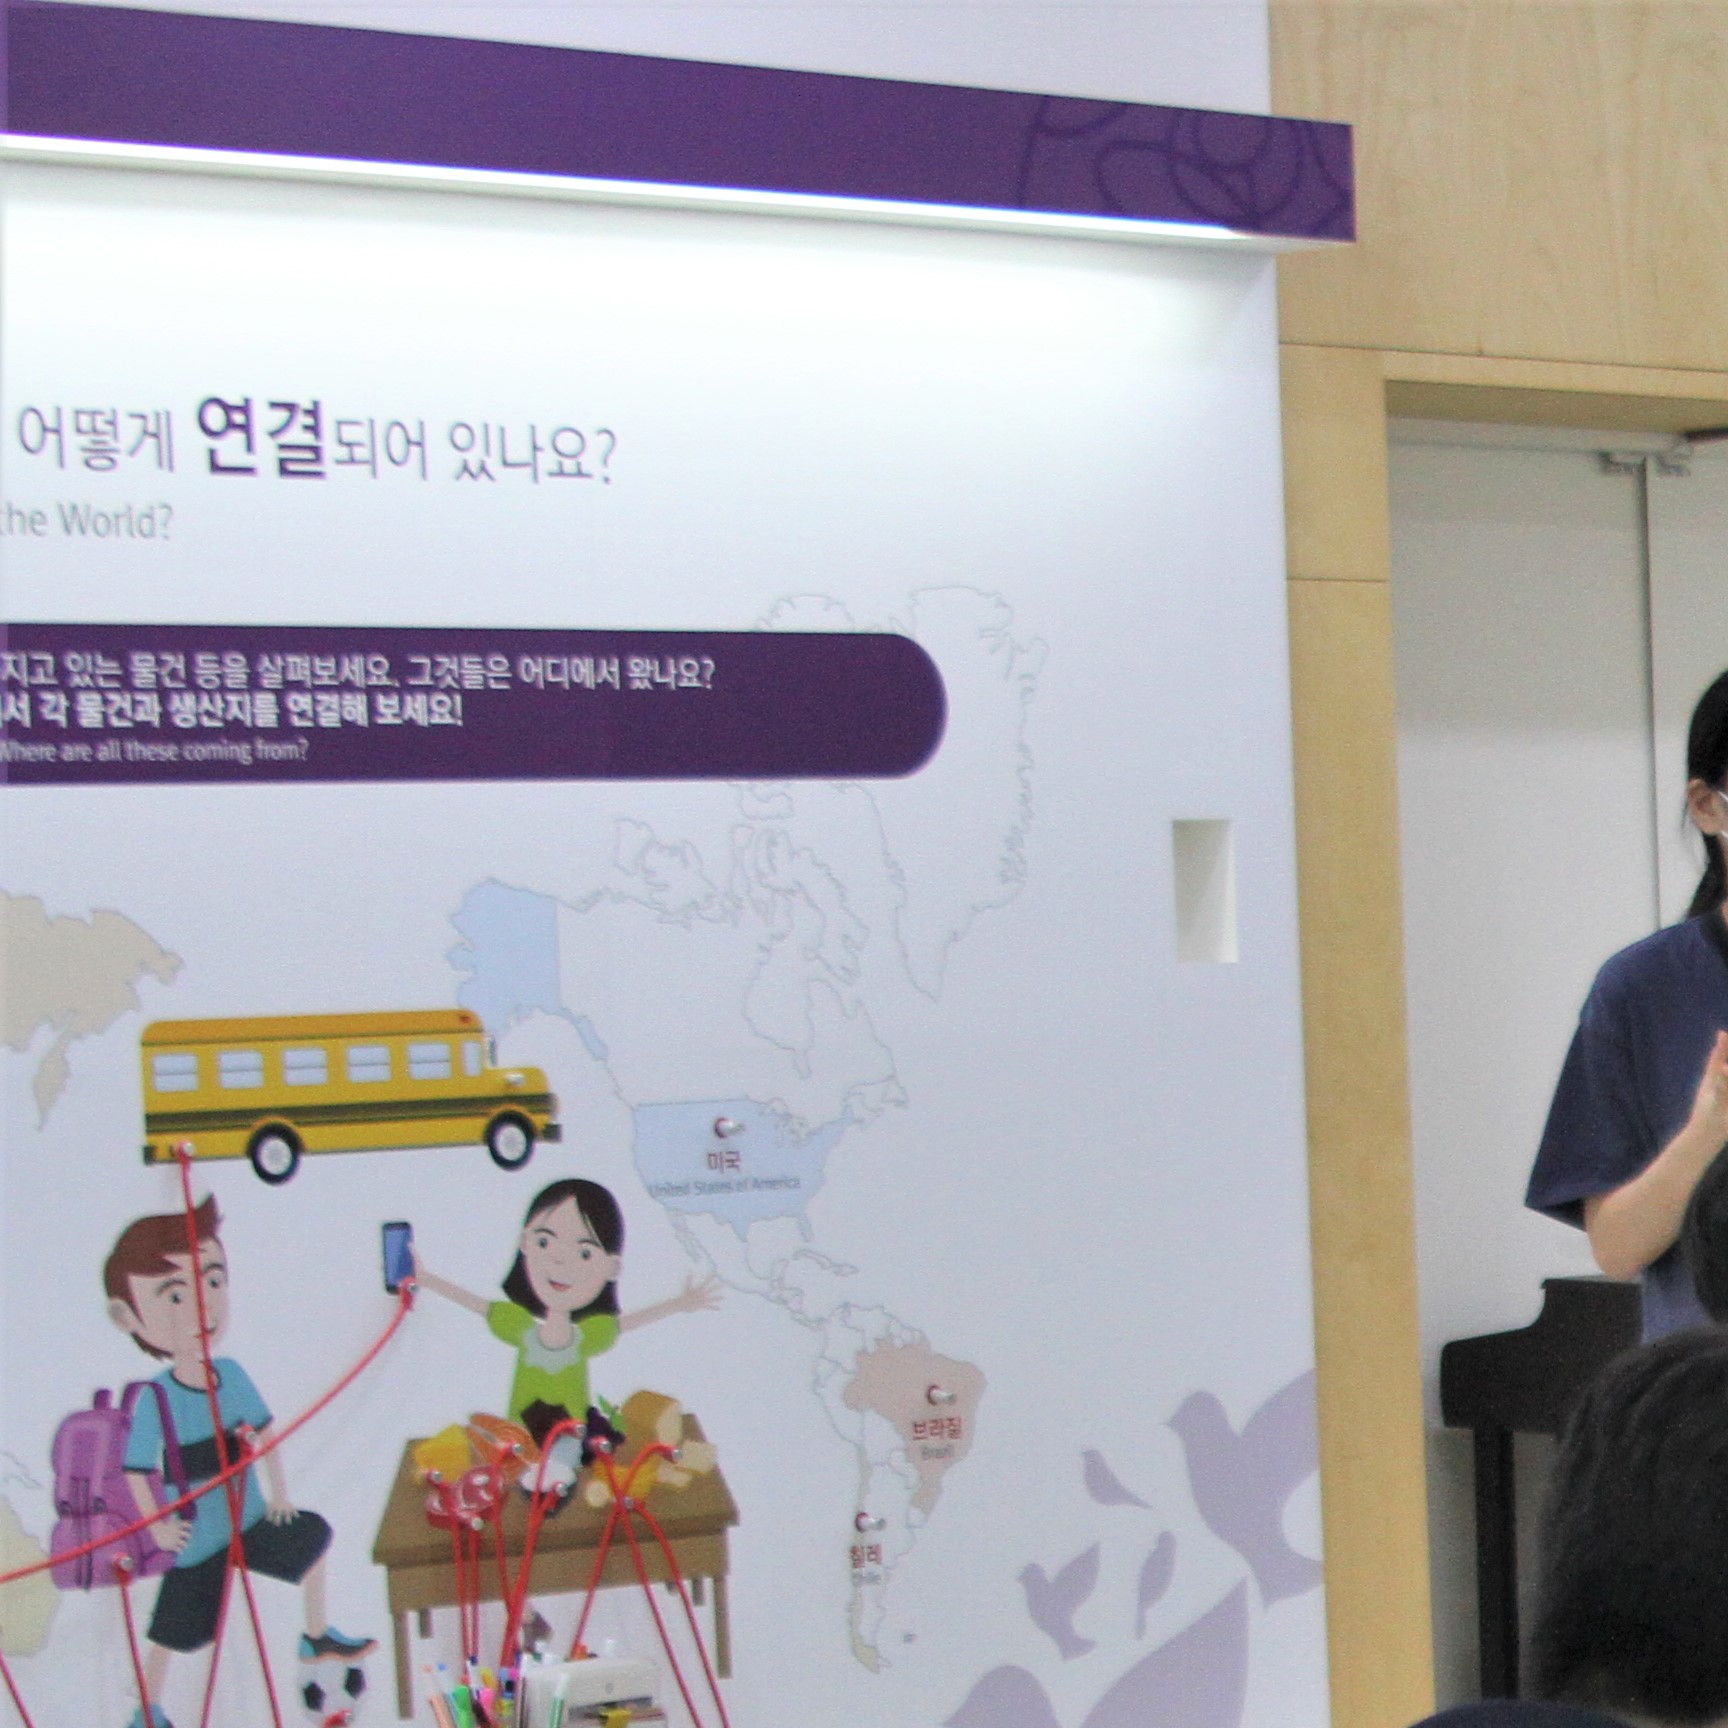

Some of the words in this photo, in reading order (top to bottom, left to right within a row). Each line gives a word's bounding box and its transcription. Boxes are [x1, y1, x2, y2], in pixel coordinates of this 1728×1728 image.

[19, 405, 175, 474] 어떻게
[198, 396, 428, 481] 연결되어
[448, 420, 617, 485] 있나요?
[58, 502, 175, 540] World?
[63, 652, 123, 689] 있는
[129, 652, 187, 689] 물건
[194, 652, 250, 690] 등을
[256, 652, 400, 690] 살펴보세요.
[407, 654, 513, 690] 그것들은
[519, 655, 621, 690] 어디에서
[626, 655, 716, 690] 왔나요?
[38, 690, 70, 729] 각
[74, 690, 161, 729] 물건과
[167, 690, 281, 729] 생산지를
[284, 690, 370, 729] 연결해
[375, 690, 464, 728] 보세요!
[62, 743, 94, 762] are
[98, 738, 124, 762] all
[125, 738, 179, 762] these
[183, 738, 253, 766] coming
[256, 736, 310, 763] from?
[707, 1150, 743, 1175] 미국
[912, 1414, 963, 1442] 브라질
